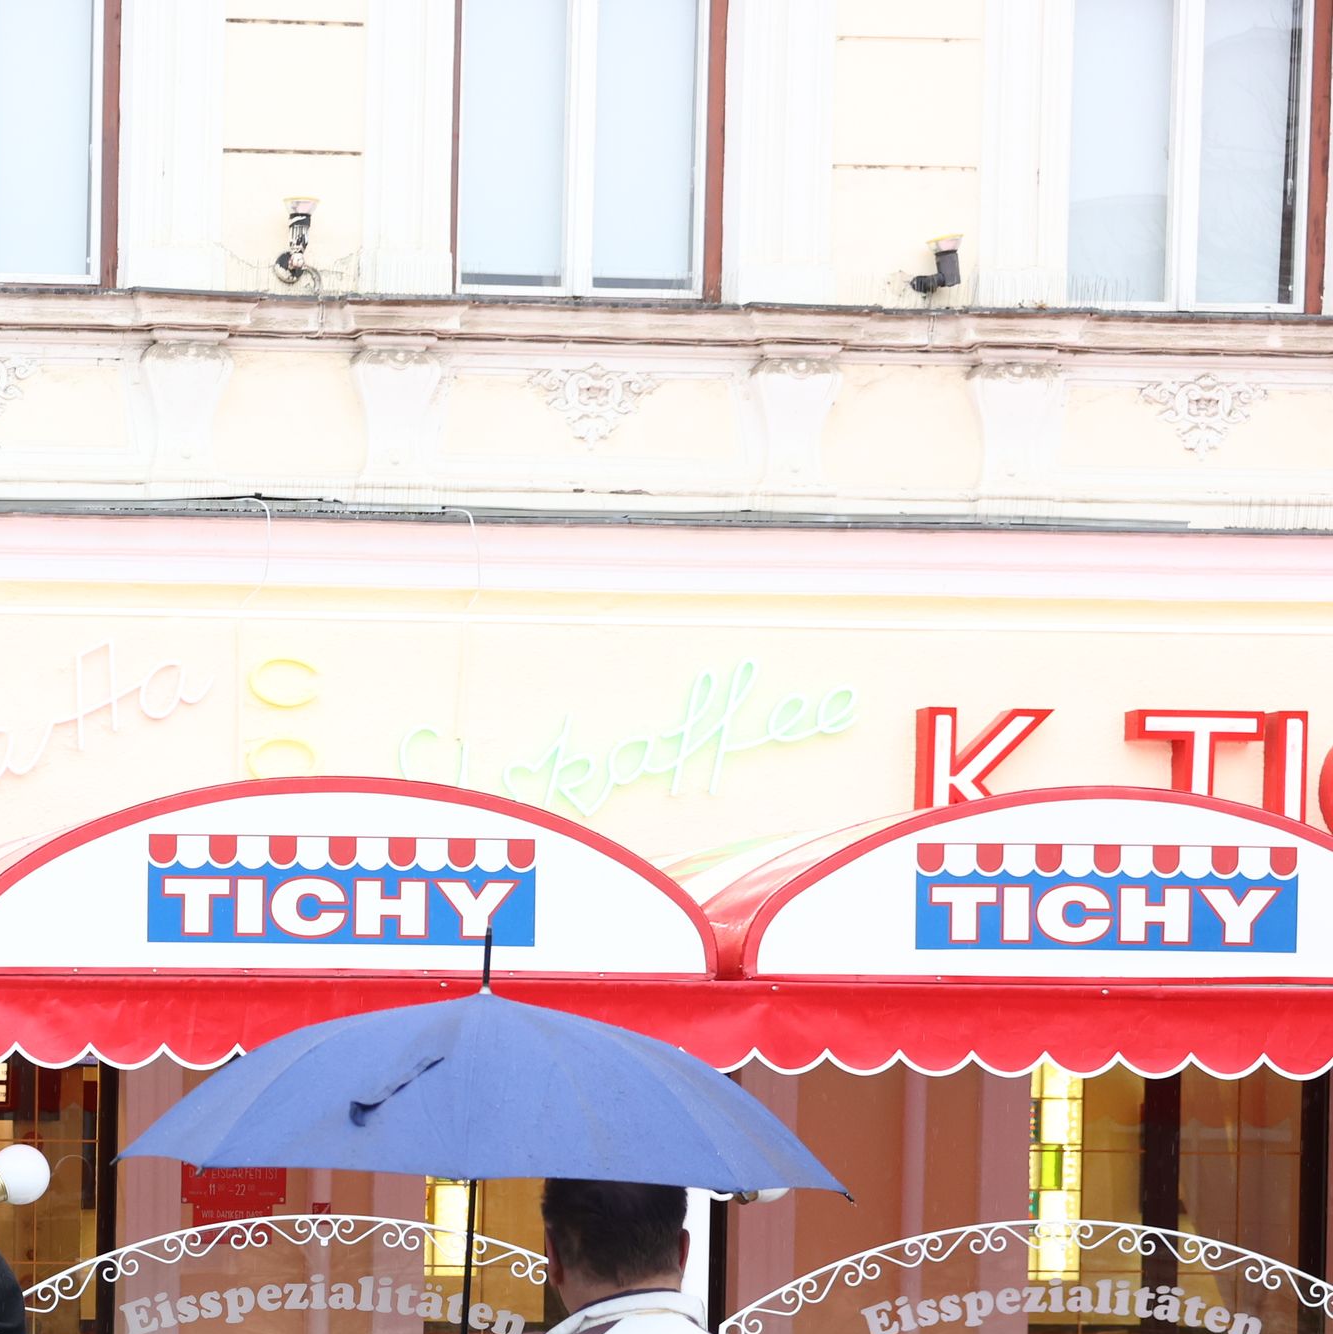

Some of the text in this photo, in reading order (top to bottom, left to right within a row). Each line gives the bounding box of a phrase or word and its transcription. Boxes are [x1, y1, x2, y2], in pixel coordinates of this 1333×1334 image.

[915, 707, 1333, 834] K TI
[162, 875, 518, 940] TICHY
[929, 883, 1283, 946] TICHY
